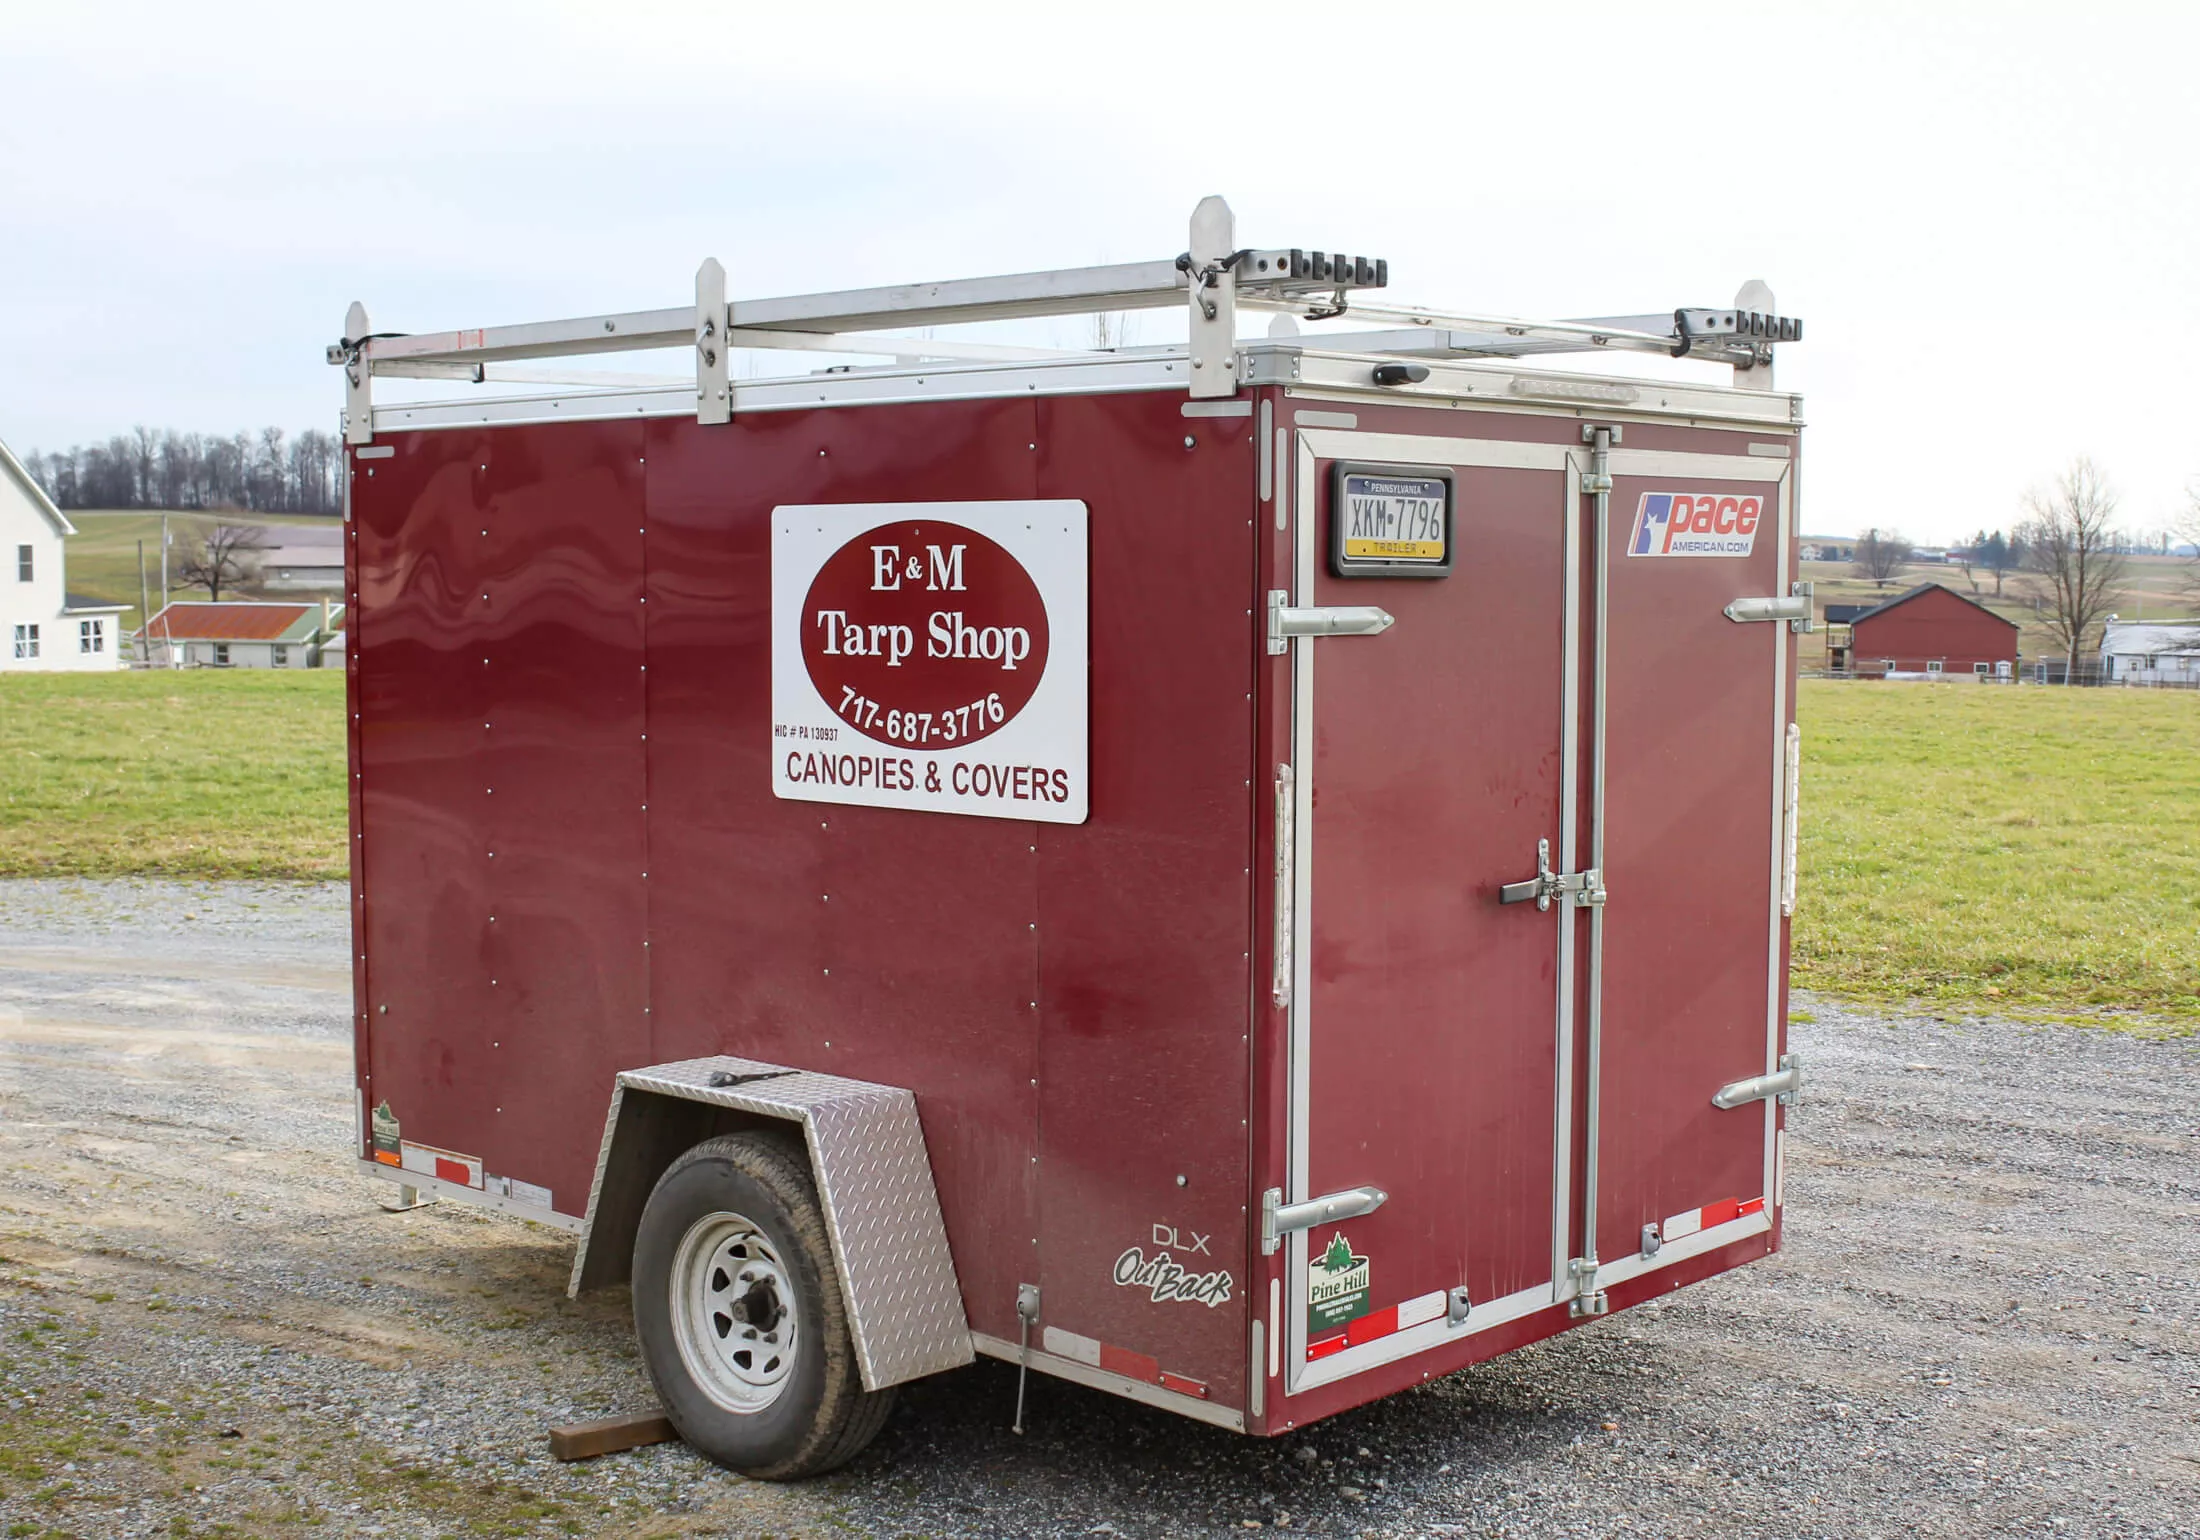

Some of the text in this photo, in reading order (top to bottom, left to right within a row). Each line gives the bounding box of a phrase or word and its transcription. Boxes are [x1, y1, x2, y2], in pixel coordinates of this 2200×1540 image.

[1371, 483, 1421, 494] PENNSYLVANIA
[1662, 496, 1759, 554] pace
[1373, 542, 1417, 553] TRAILER
[1671, 541, 1749, 553] AMERICAN.COM
[817, 610, 1031, 670] Tarp Shop
[838, 685, 1005, 743] 717-687-3776
[774, 724, 788, 738] HIC
[799, 726, 809, 739] PA
[811, 727, 839, 741] 130937
[786, 751, 1070, 804] CANOPIES & COVERS
[1153, 1223, 1211, 1256] DLX
[1311, 1281, 1341, 1302] Pine
[1343, 1269, 1367, 1292] Hill
